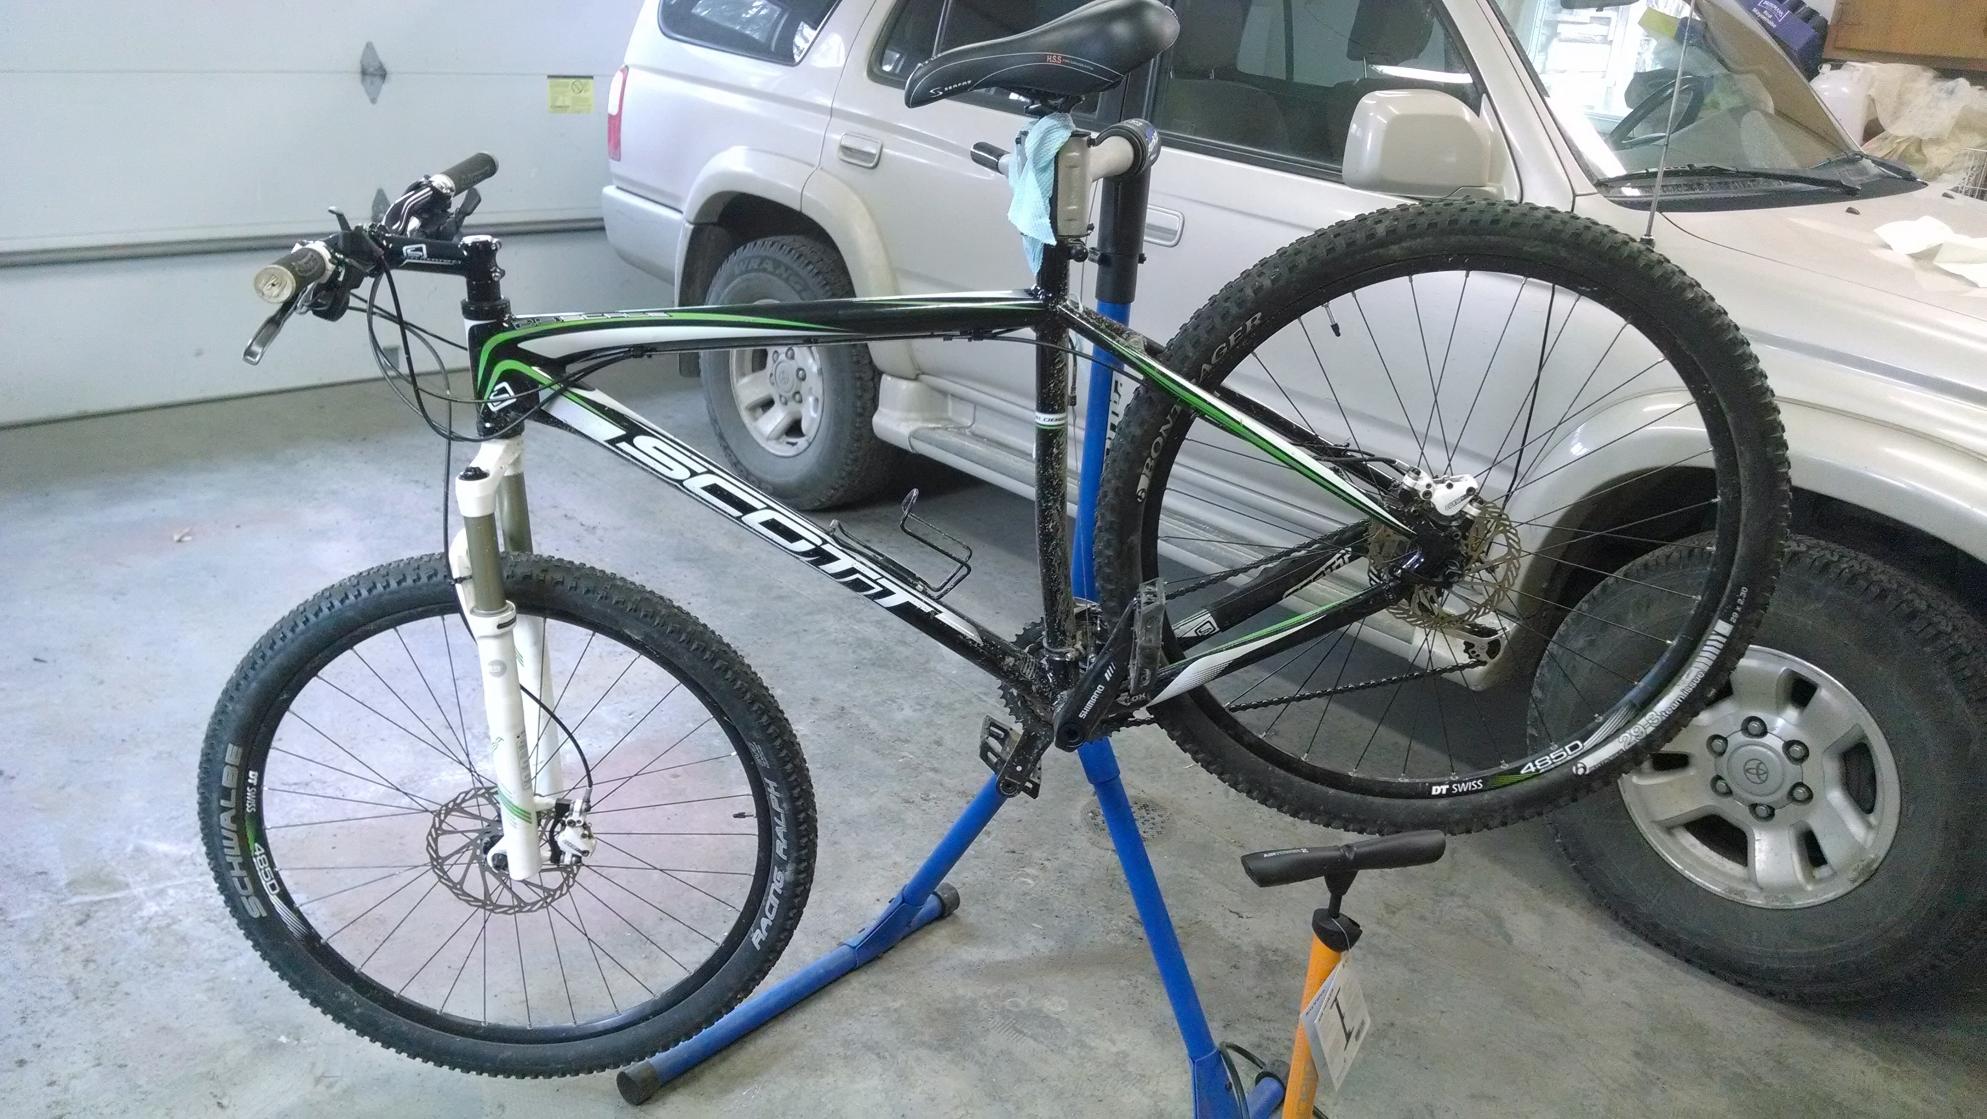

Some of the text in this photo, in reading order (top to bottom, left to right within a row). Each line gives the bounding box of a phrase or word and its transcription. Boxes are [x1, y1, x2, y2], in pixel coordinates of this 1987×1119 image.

[615, 434, 935, 616] SCOTT
[1079, 684, 1105, 719] SHIMANO
[1520, 740, 1584, 774] 485D
[246, 786, 257, 813] SWISS
[1431, 779, 1484, 796] DT SWISS
[220, 743, 268, 919] SCHWALBE
[253, 841, 281, 895] 485D
[751, 777, 788, 951] RACING RALPH
